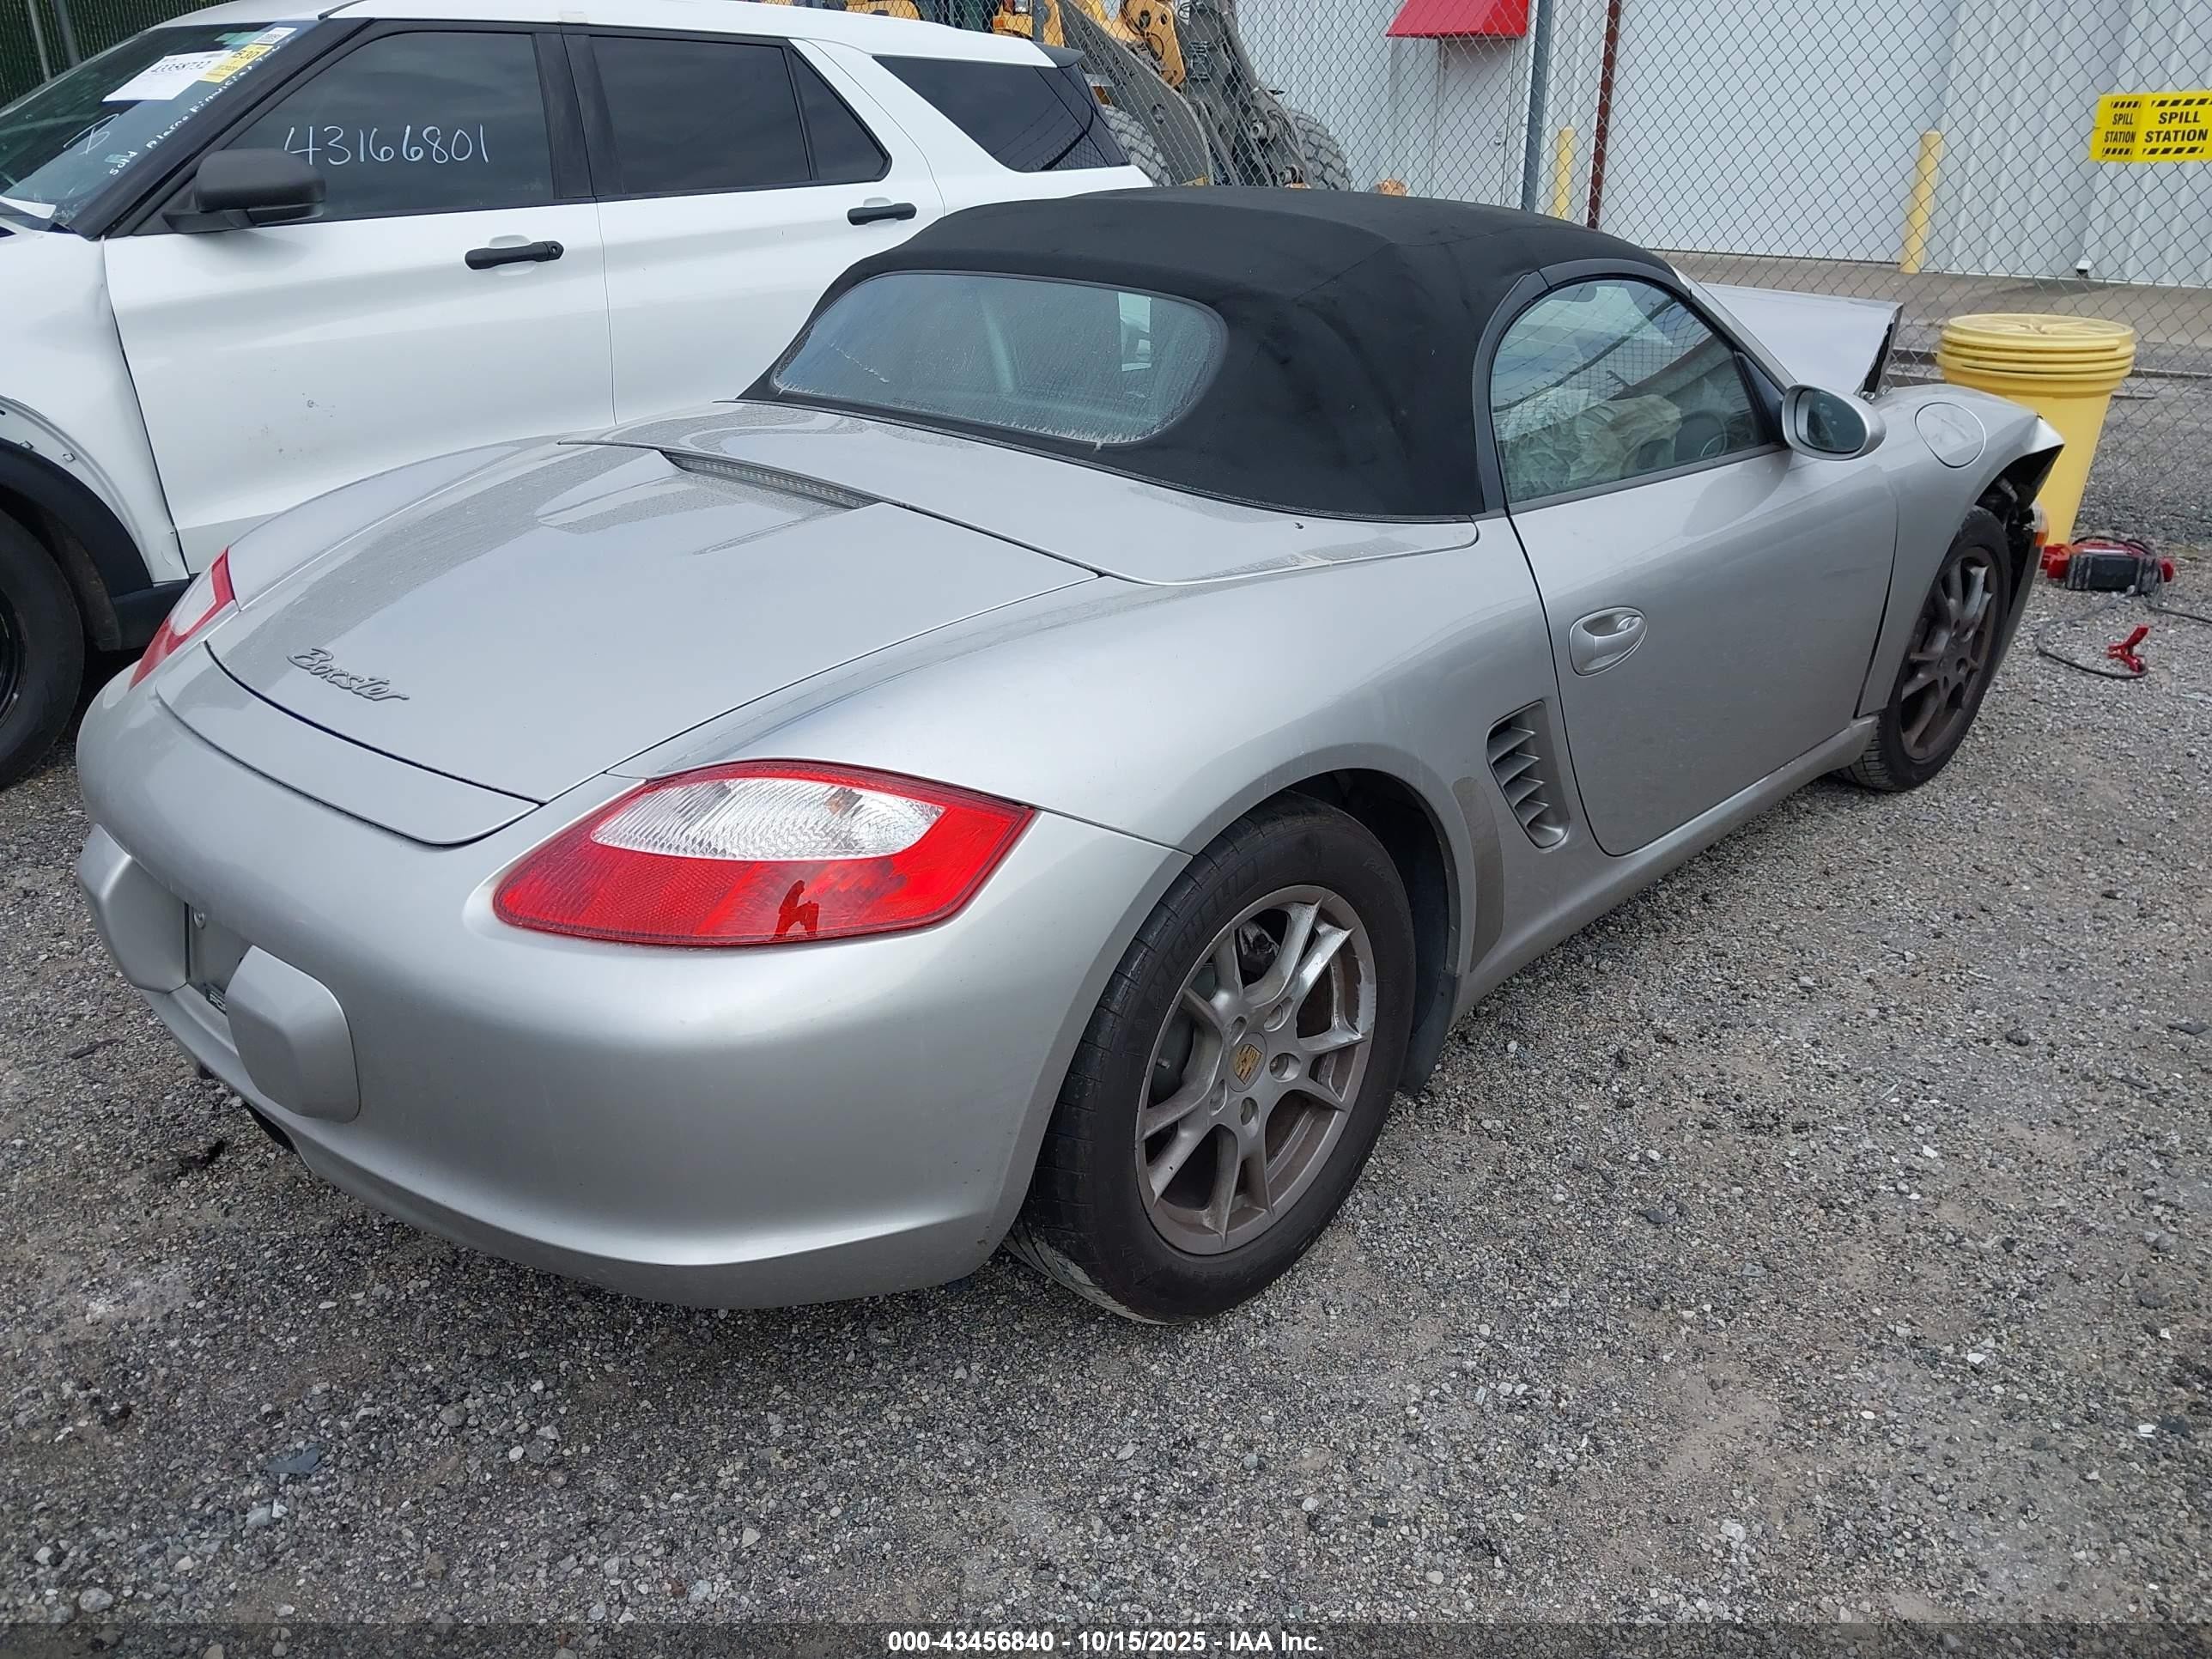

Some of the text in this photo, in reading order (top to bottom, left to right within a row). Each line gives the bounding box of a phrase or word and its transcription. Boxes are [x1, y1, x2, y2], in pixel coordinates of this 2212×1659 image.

[2112, 113, 2134, 125] SPILL
[2158, 111, 2201, 125] SPILL
[2104, 131, 2136, 143] STATION
[2144, 129, 2209, 143] STATION
[283, 124, 489, 166] 43166801
[287, 647, 410, 702] Boxster
